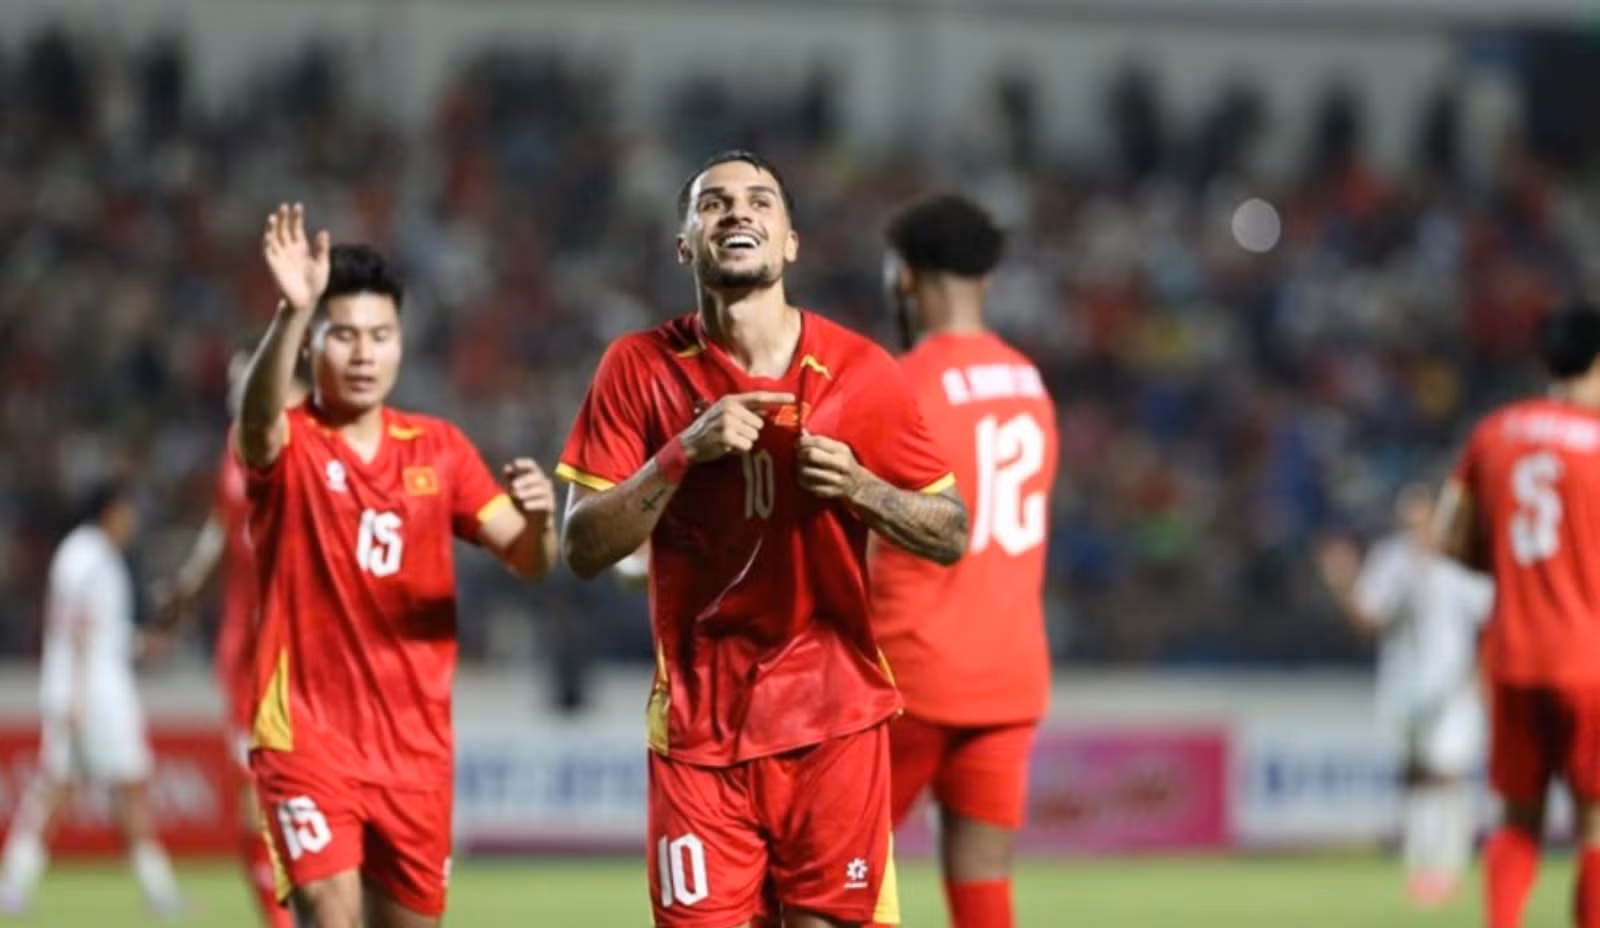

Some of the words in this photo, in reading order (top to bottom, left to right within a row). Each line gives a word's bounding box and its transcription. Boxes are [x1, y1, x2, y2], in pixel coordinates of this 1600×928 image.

[741, 449, 775, 519] 10
[972, 414, 1046, 556] 12
[356, 507, 404, 577] 15
[278, 794, 332, 860] 15
[658, 832, 709, 907] 10
